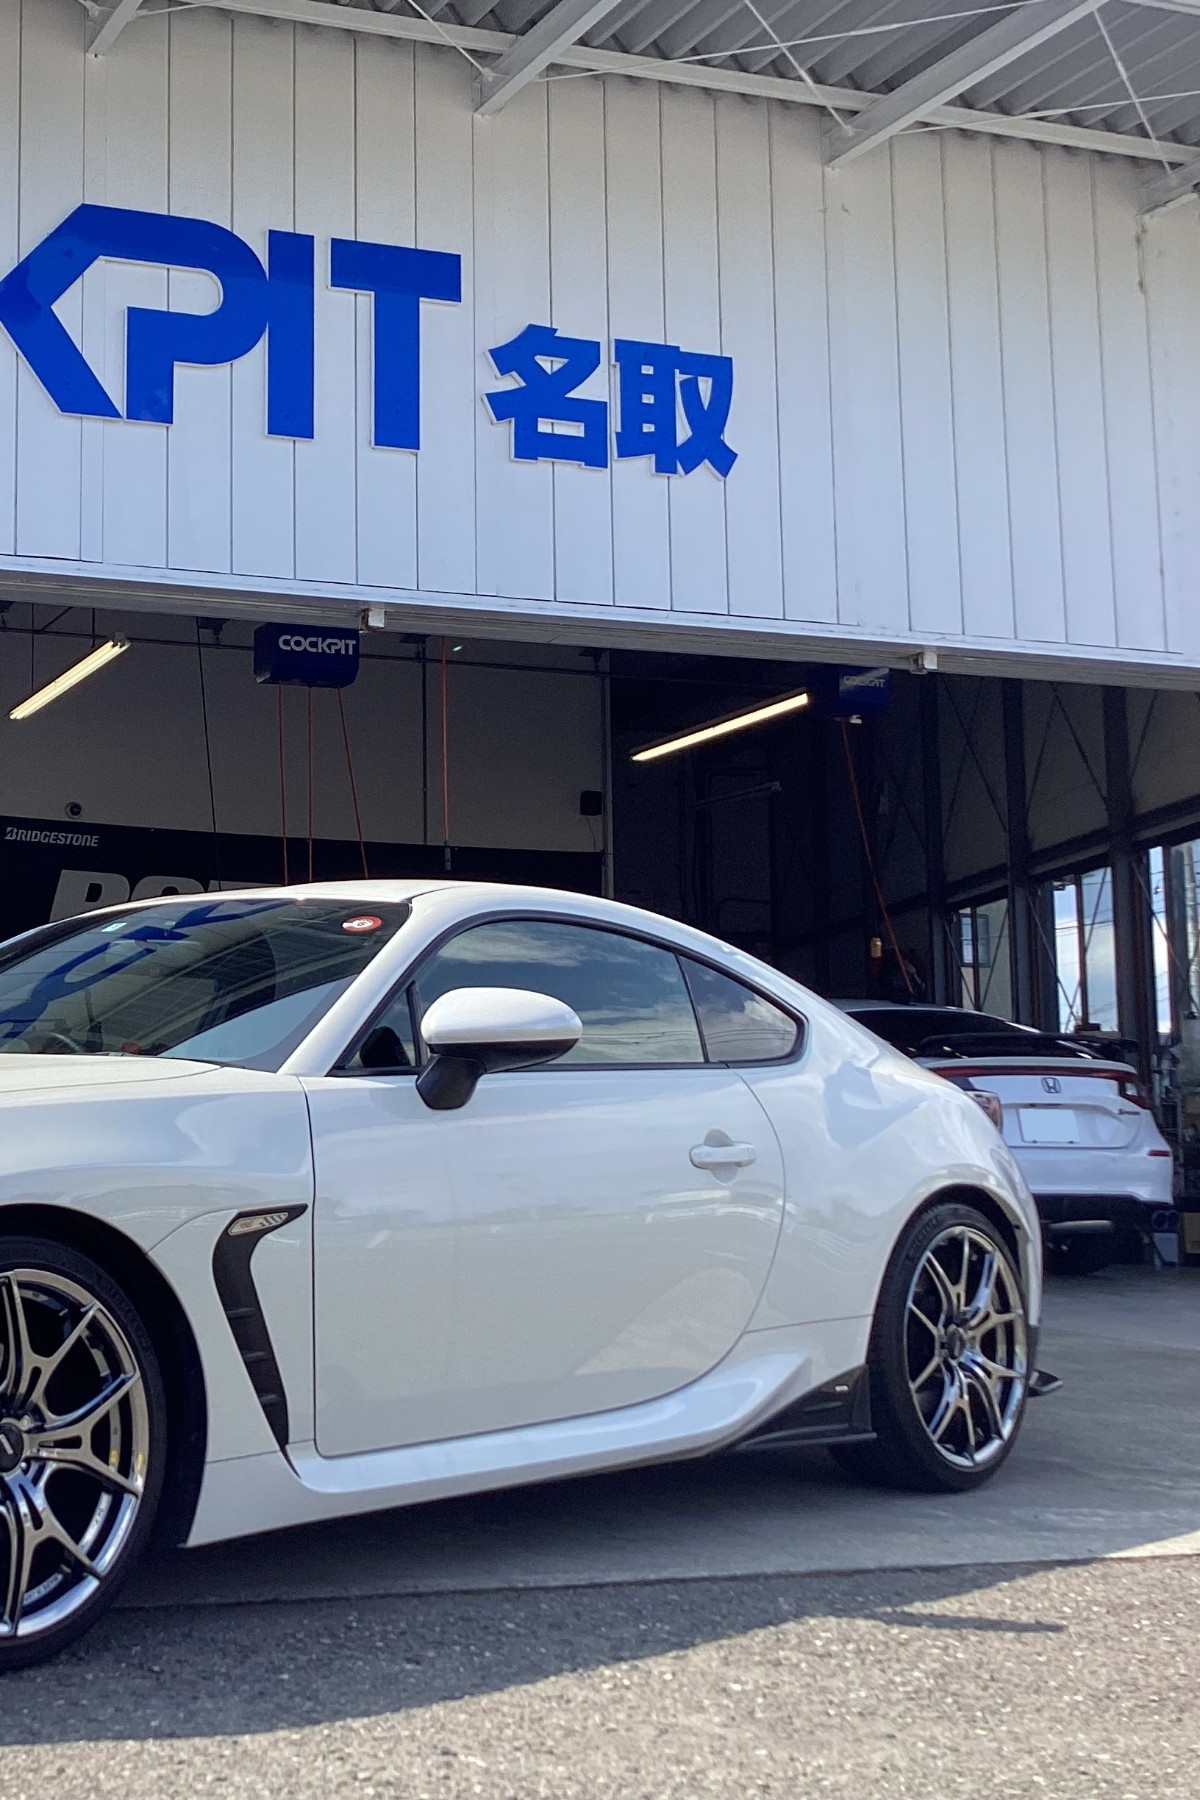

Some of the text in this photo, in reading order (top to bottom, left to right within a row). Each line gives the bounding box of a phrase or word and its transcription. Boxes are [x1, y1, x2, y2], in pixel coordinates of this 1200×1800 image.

[485, 323, 738, 478] 名取
[278, 634, 357, 656] COCKPIT
[4, 826, 100, 848] BRIDGESTONE
